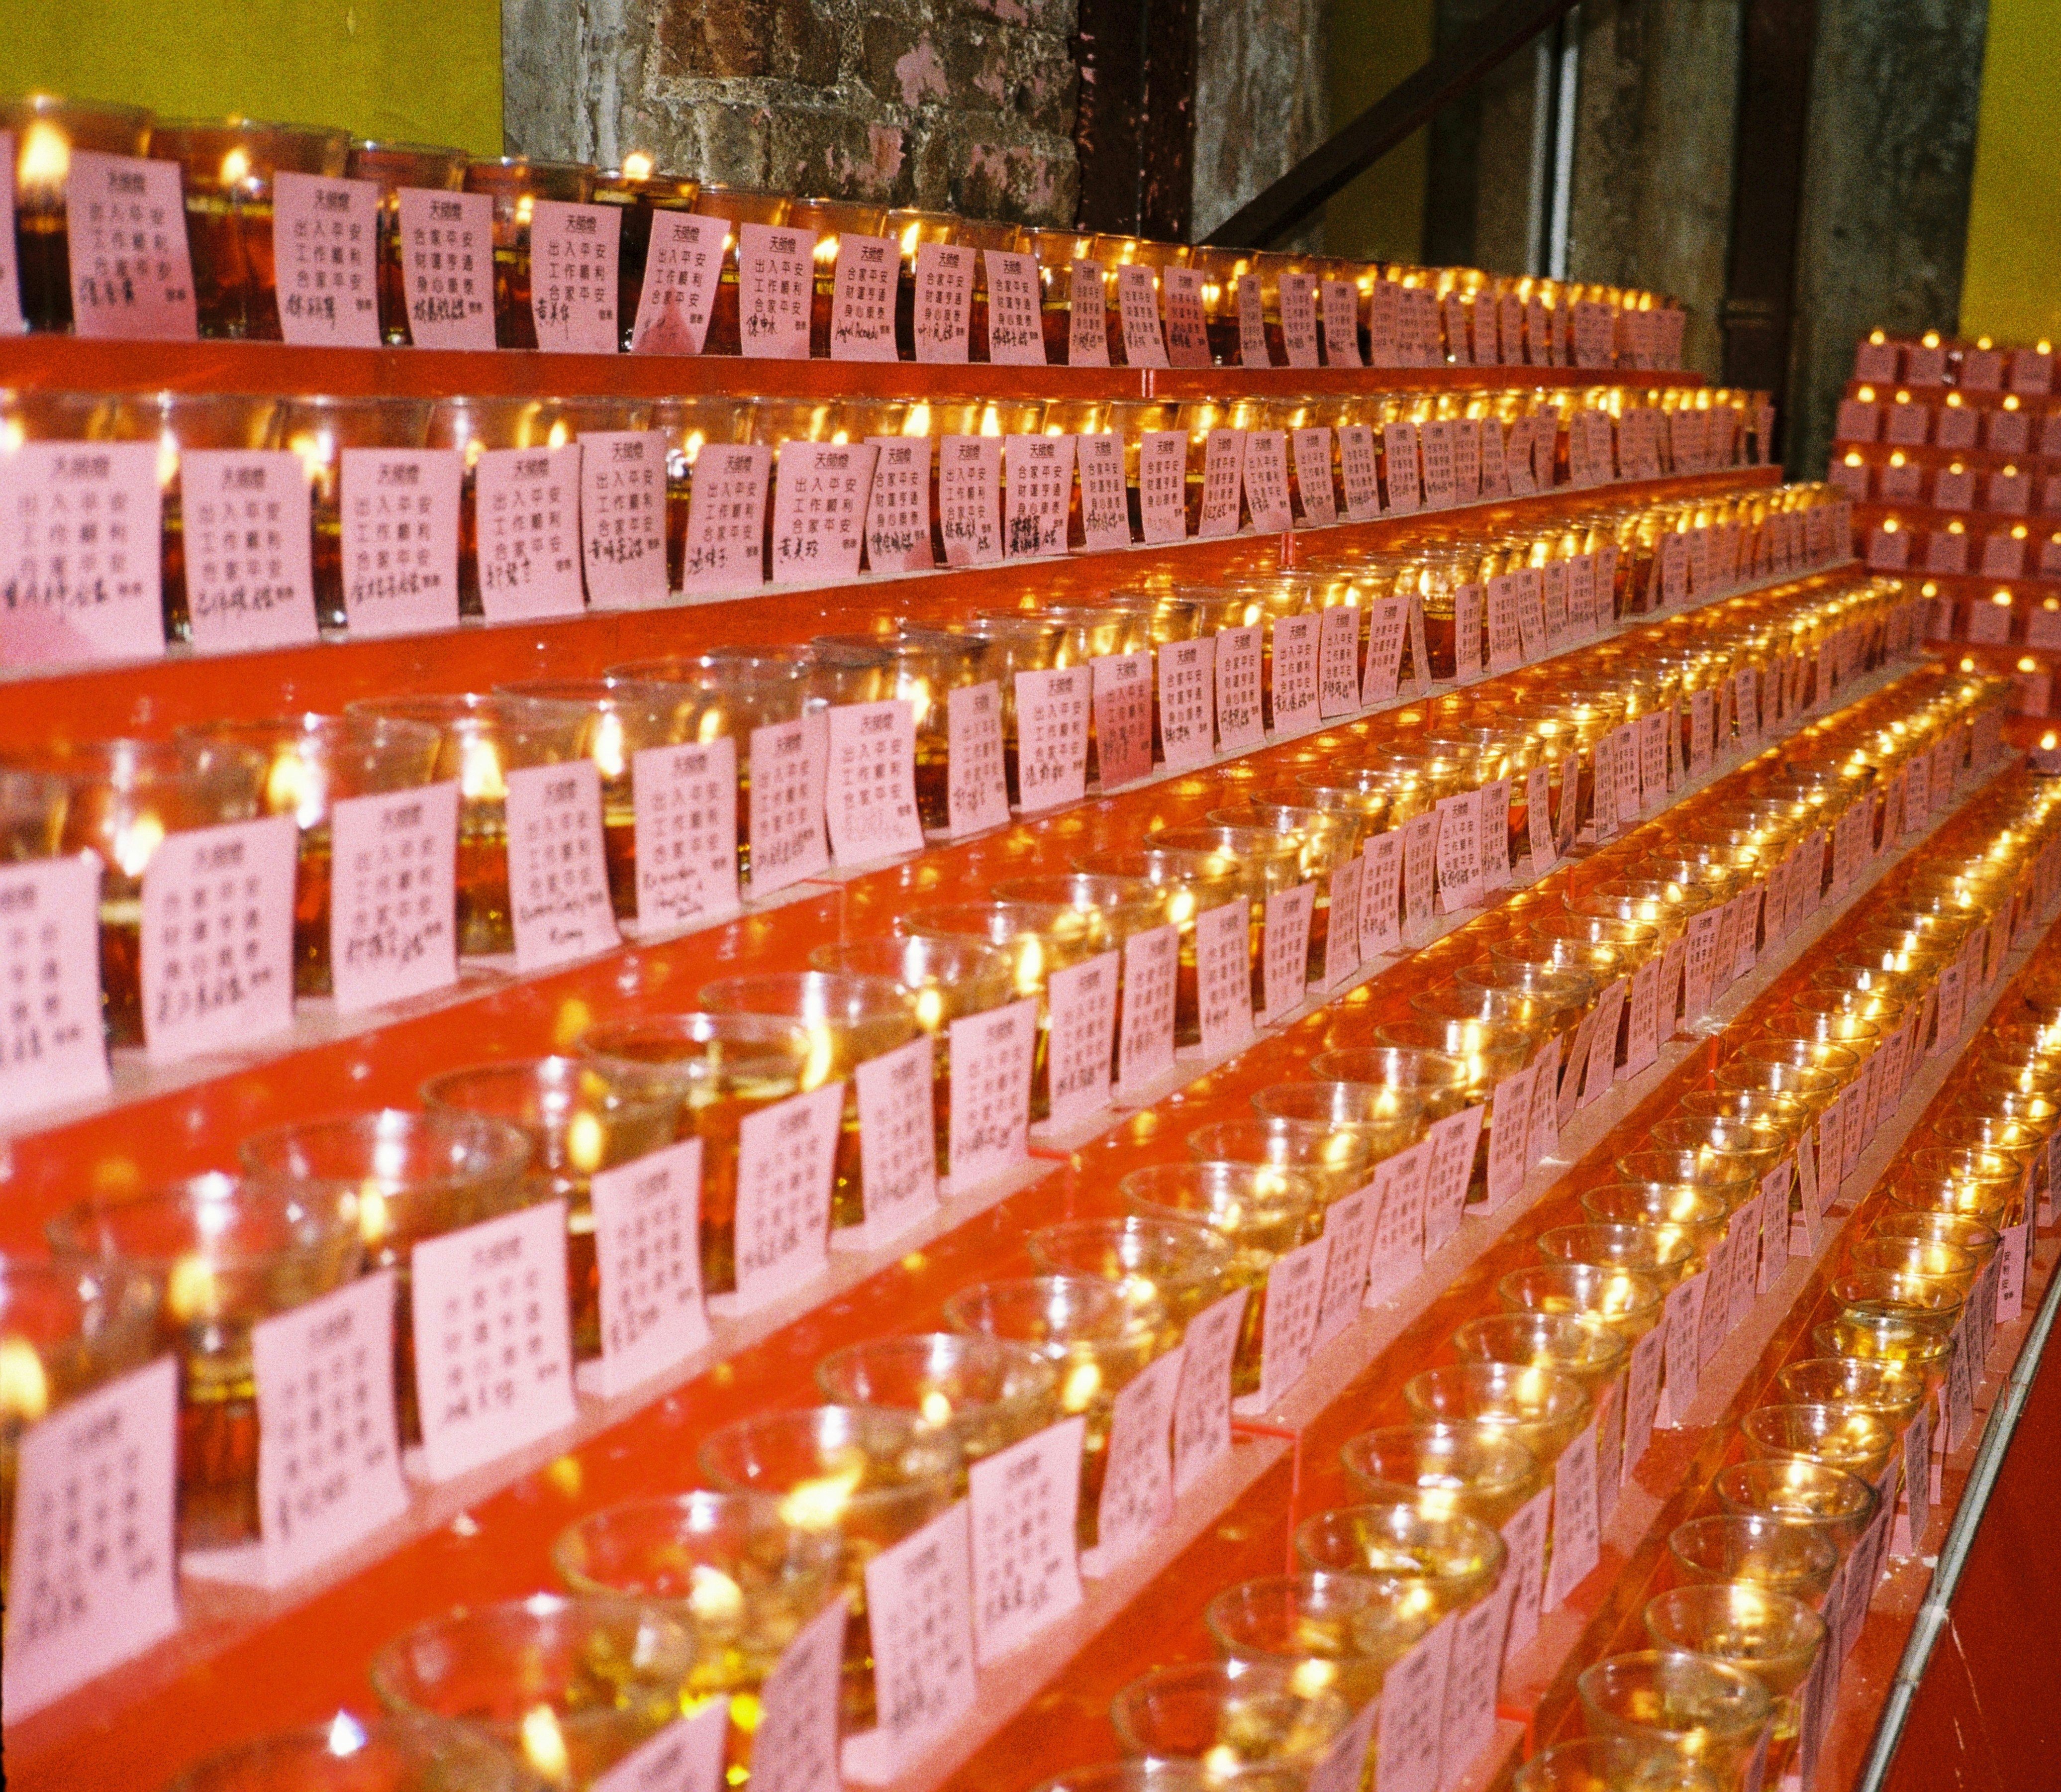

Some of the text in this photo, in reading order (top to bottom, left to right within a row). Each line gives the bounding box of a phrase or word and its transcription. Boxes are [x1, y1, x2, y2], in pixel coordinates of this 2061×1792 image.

[755, 259, 803, 276] 出入平安
[848, 267, 887, 283] 合家平安
[754, 279, 802, 296] 工作順利
[846, 286, 886, 301] 財運亨通
[755, 299, 801, 315] 合家平安
[845, 304, 884, 319] 身心康泰
[876, 472, 918, 488] 合家平安
[1018, 466, 1062, 479] 合家平安
[795, 478, 856, 493] 出入平安
[1018, 483, 1060, 498] 財運亨通
[793, 498, 853, 512] 工作順利
[876, 491, 918, 507] 財運亨通
[1018, 501, 1059, 514] 身心康泰
[793, 519, 851, 534] 合家平安
[877, 511, 918, 527] 身心康泰
